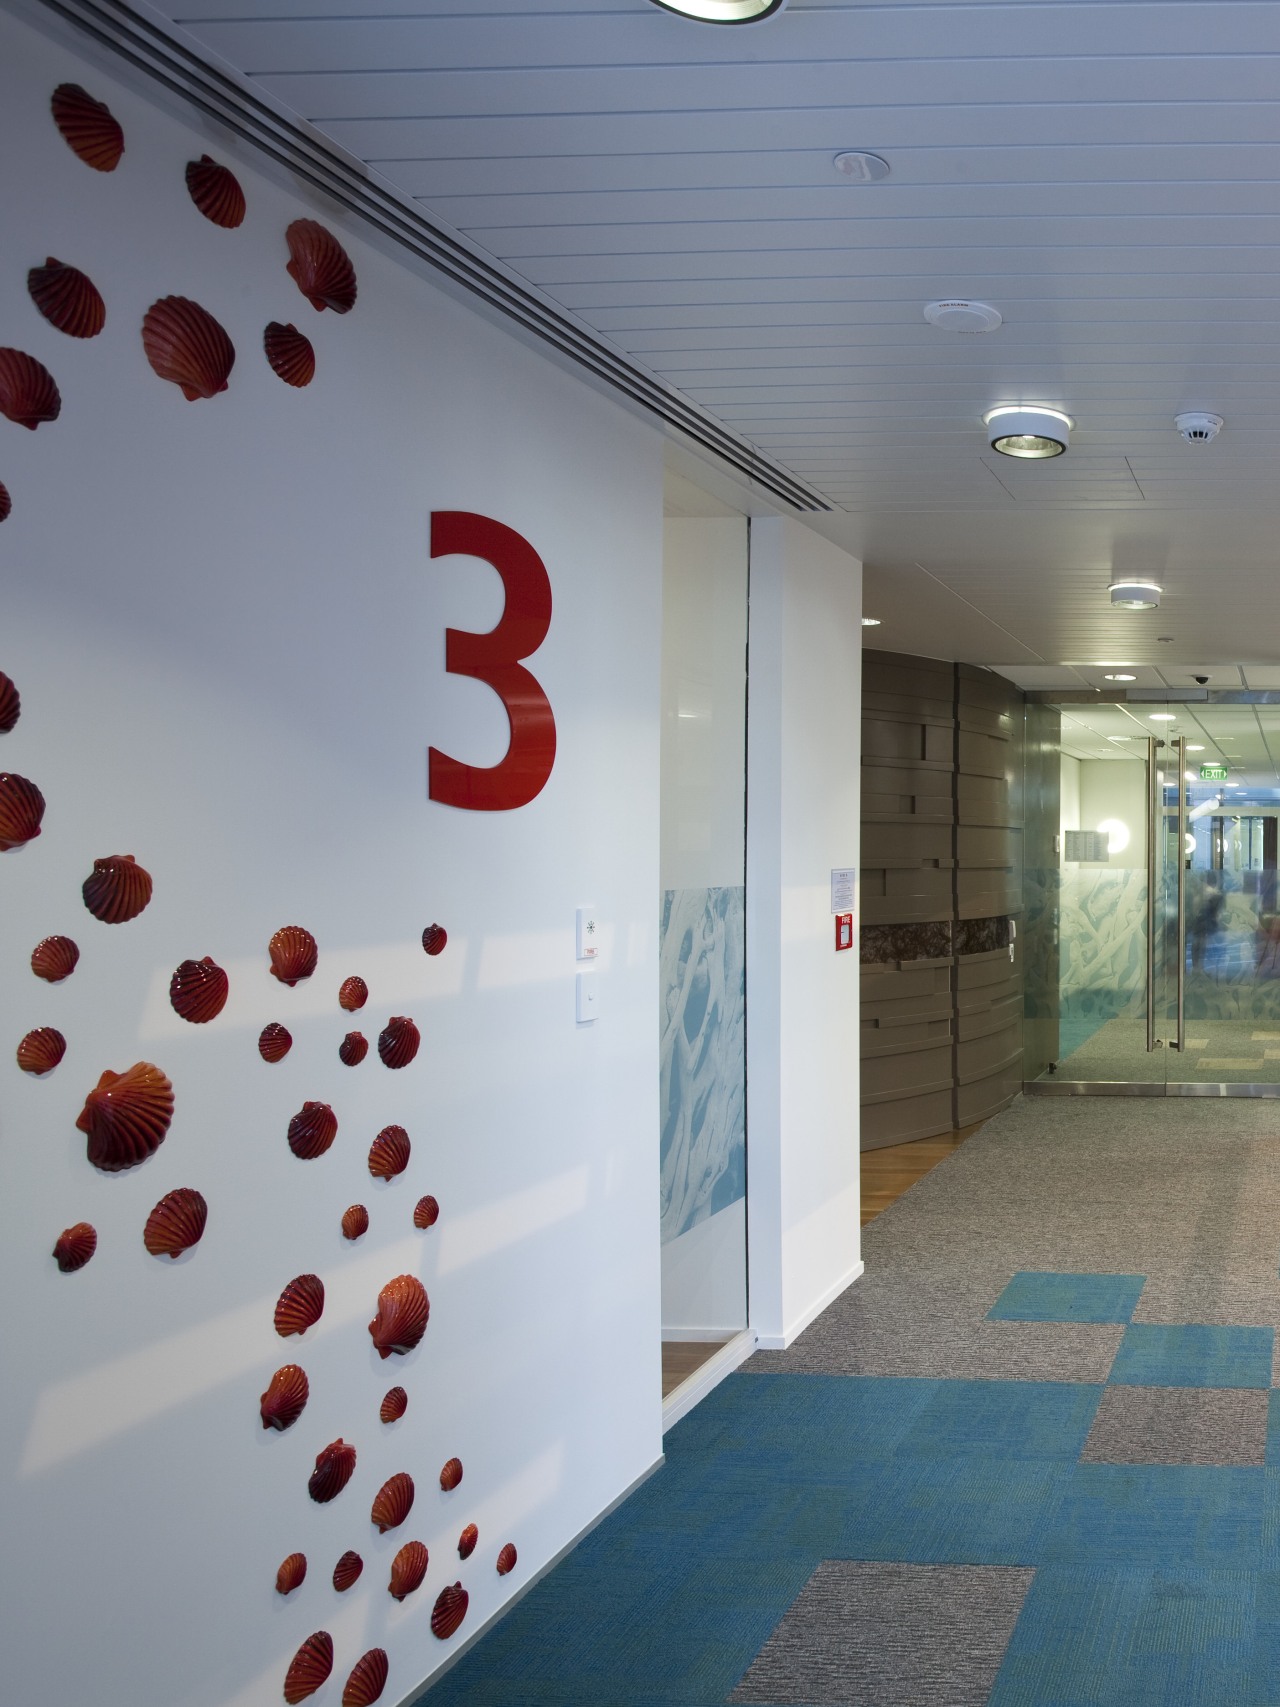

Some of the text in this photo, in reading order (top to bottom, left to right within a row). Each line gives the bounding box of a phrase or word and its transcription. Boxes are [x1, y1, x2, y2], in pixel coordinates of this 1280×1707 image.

[429, 511, 557, 812] 3
[1205, 769, 1223, 779] EXIT
[841, 916, 851, 924] FIRE
